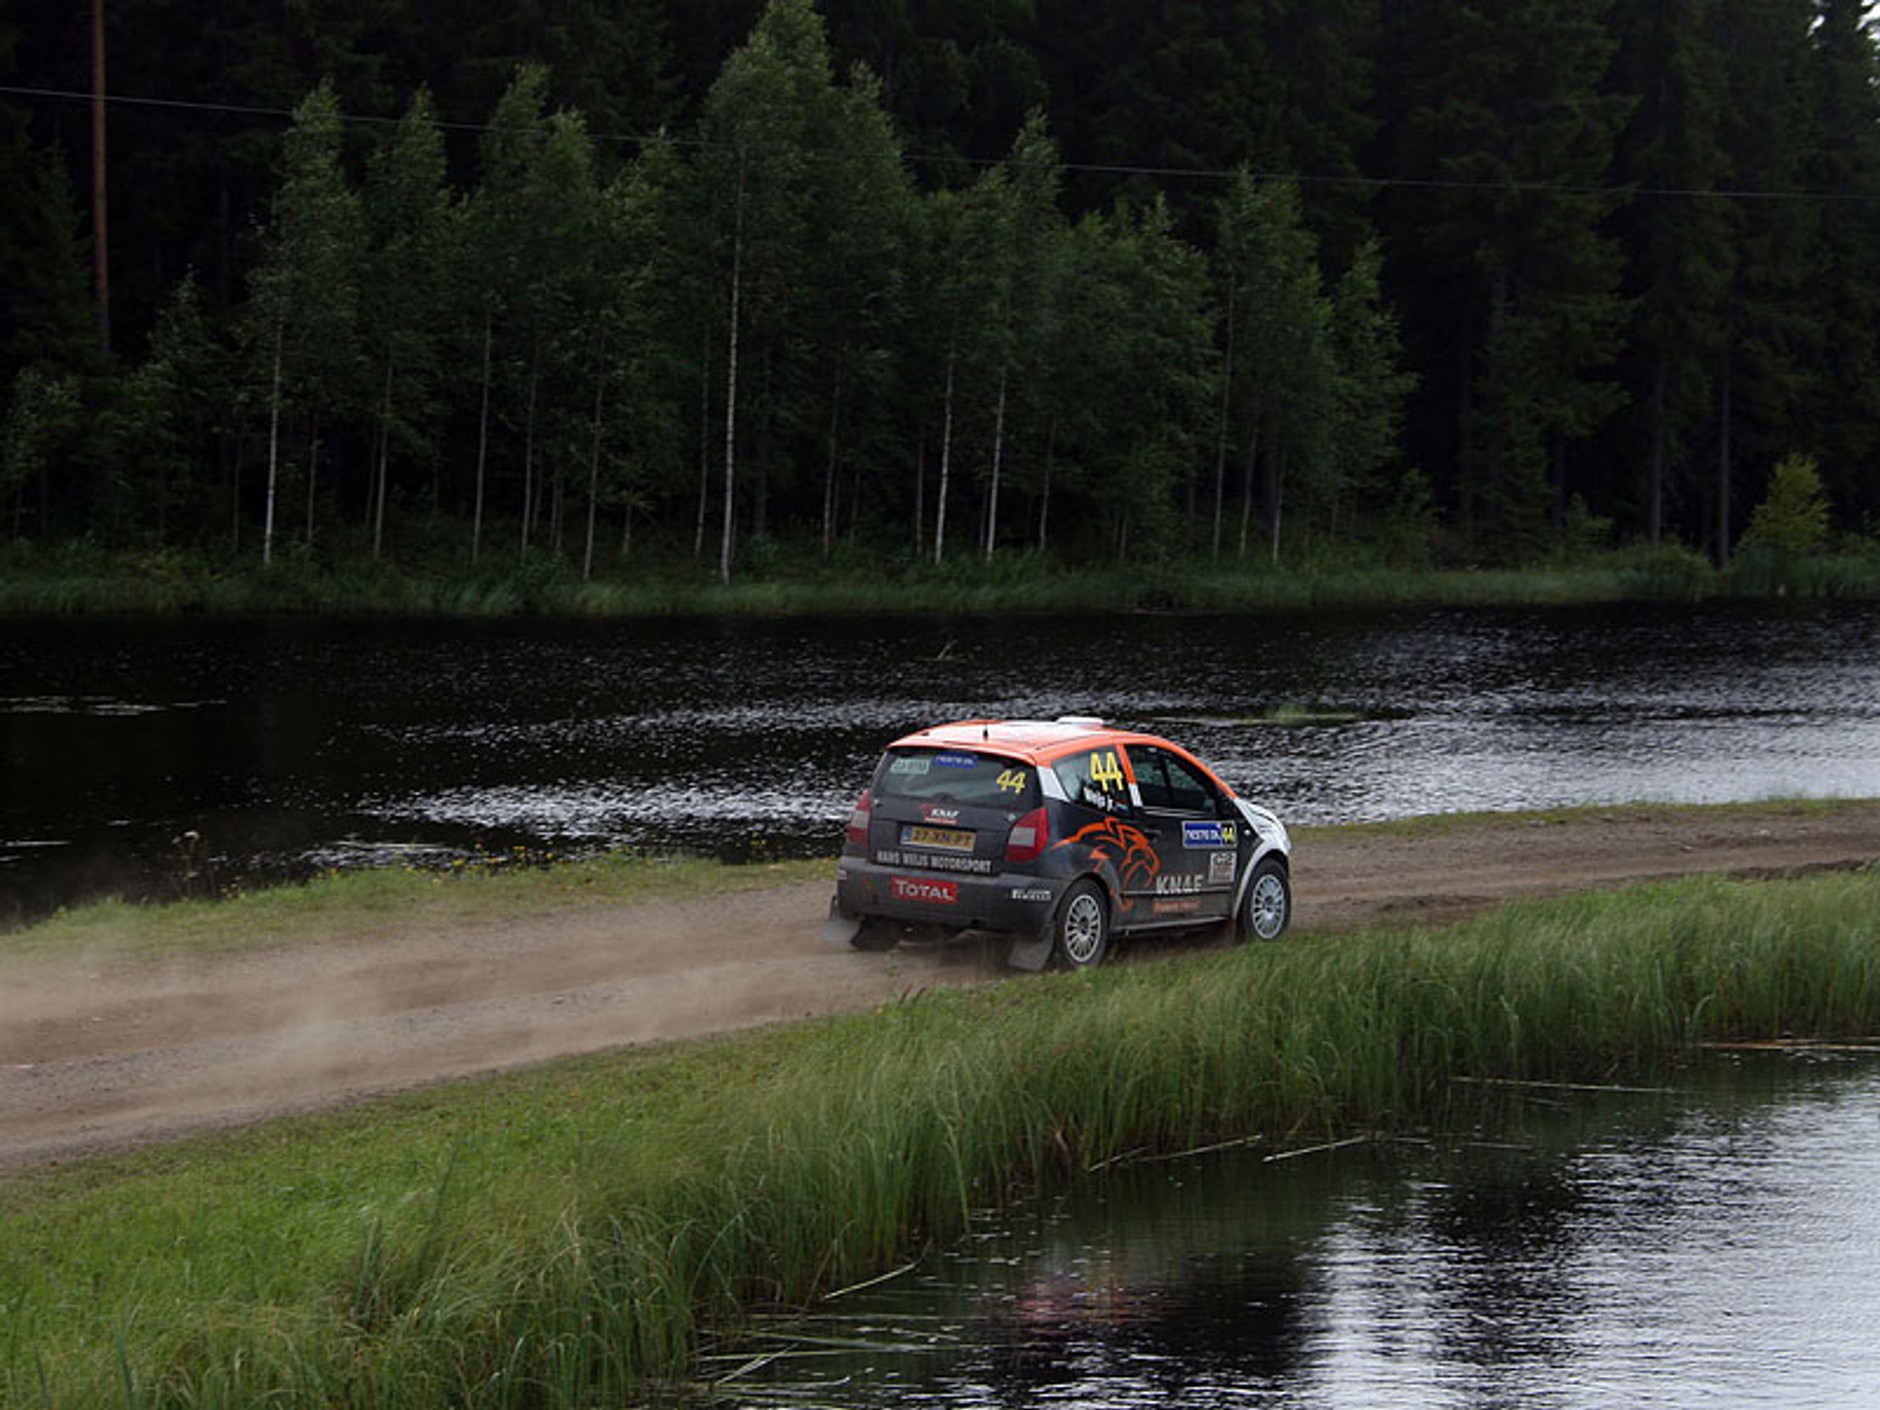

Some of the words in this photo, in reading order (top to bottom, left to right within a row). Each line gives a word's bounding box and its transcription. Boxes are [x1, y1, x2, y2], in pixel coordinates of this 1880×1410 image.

[996, 769, 1026, 794] 44
[1090, 752, 1124, 791] 44
[1222, 827, 1234, 842] 44
[931, 855, 991, 873] MOTORSPORT
[895, 879, 955, 901] TOTAL
